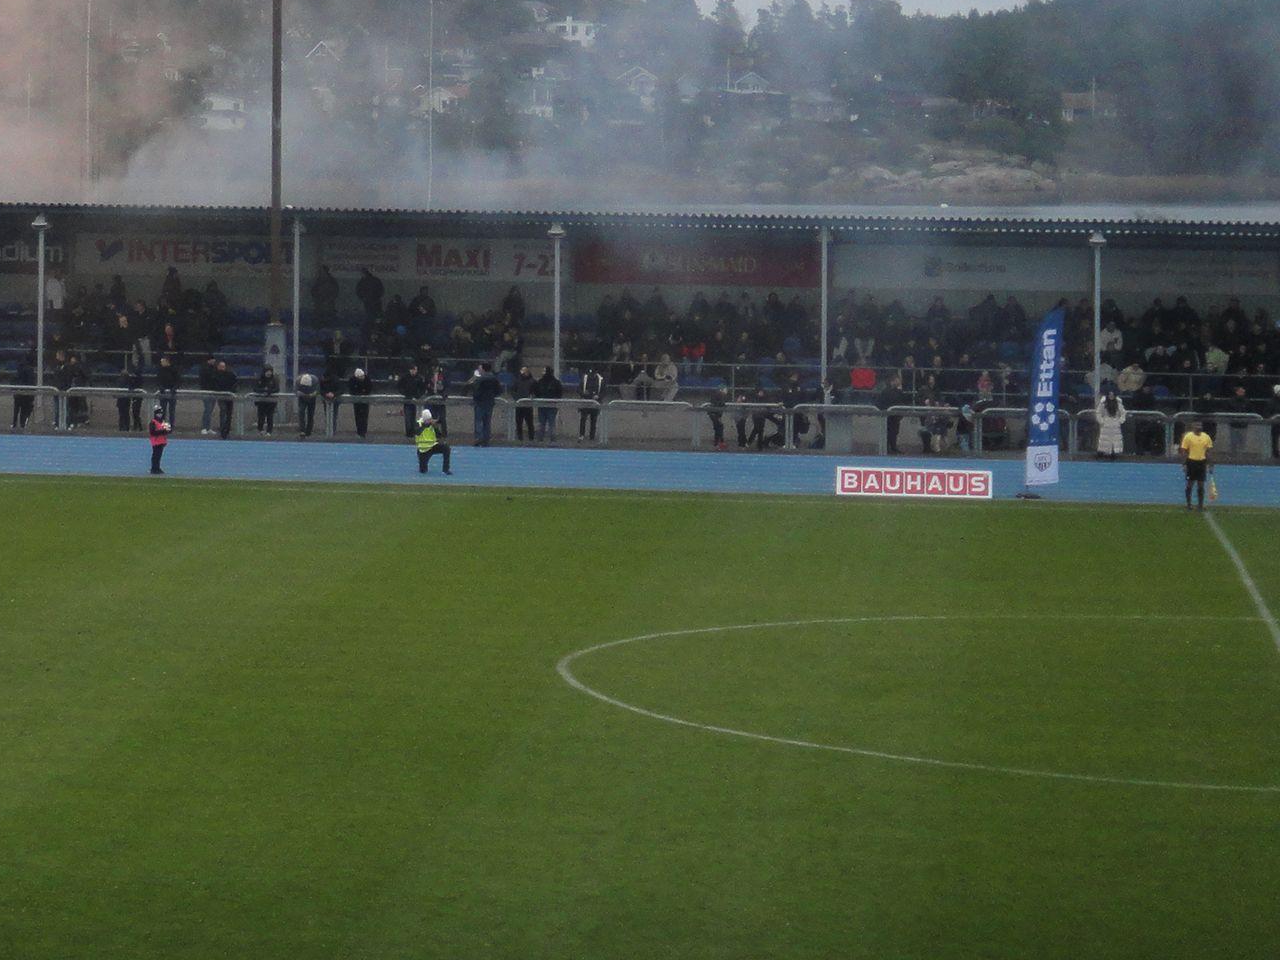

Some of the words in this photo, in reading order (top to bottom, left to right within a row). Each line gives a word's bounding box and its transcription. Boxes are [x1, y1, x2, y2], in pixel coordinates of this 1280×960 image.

[416, 244, 491, 272] MAXI
[1037, 328, 1057, 397] Ettan
[843, 472, 986, 492] BAUHAUS
